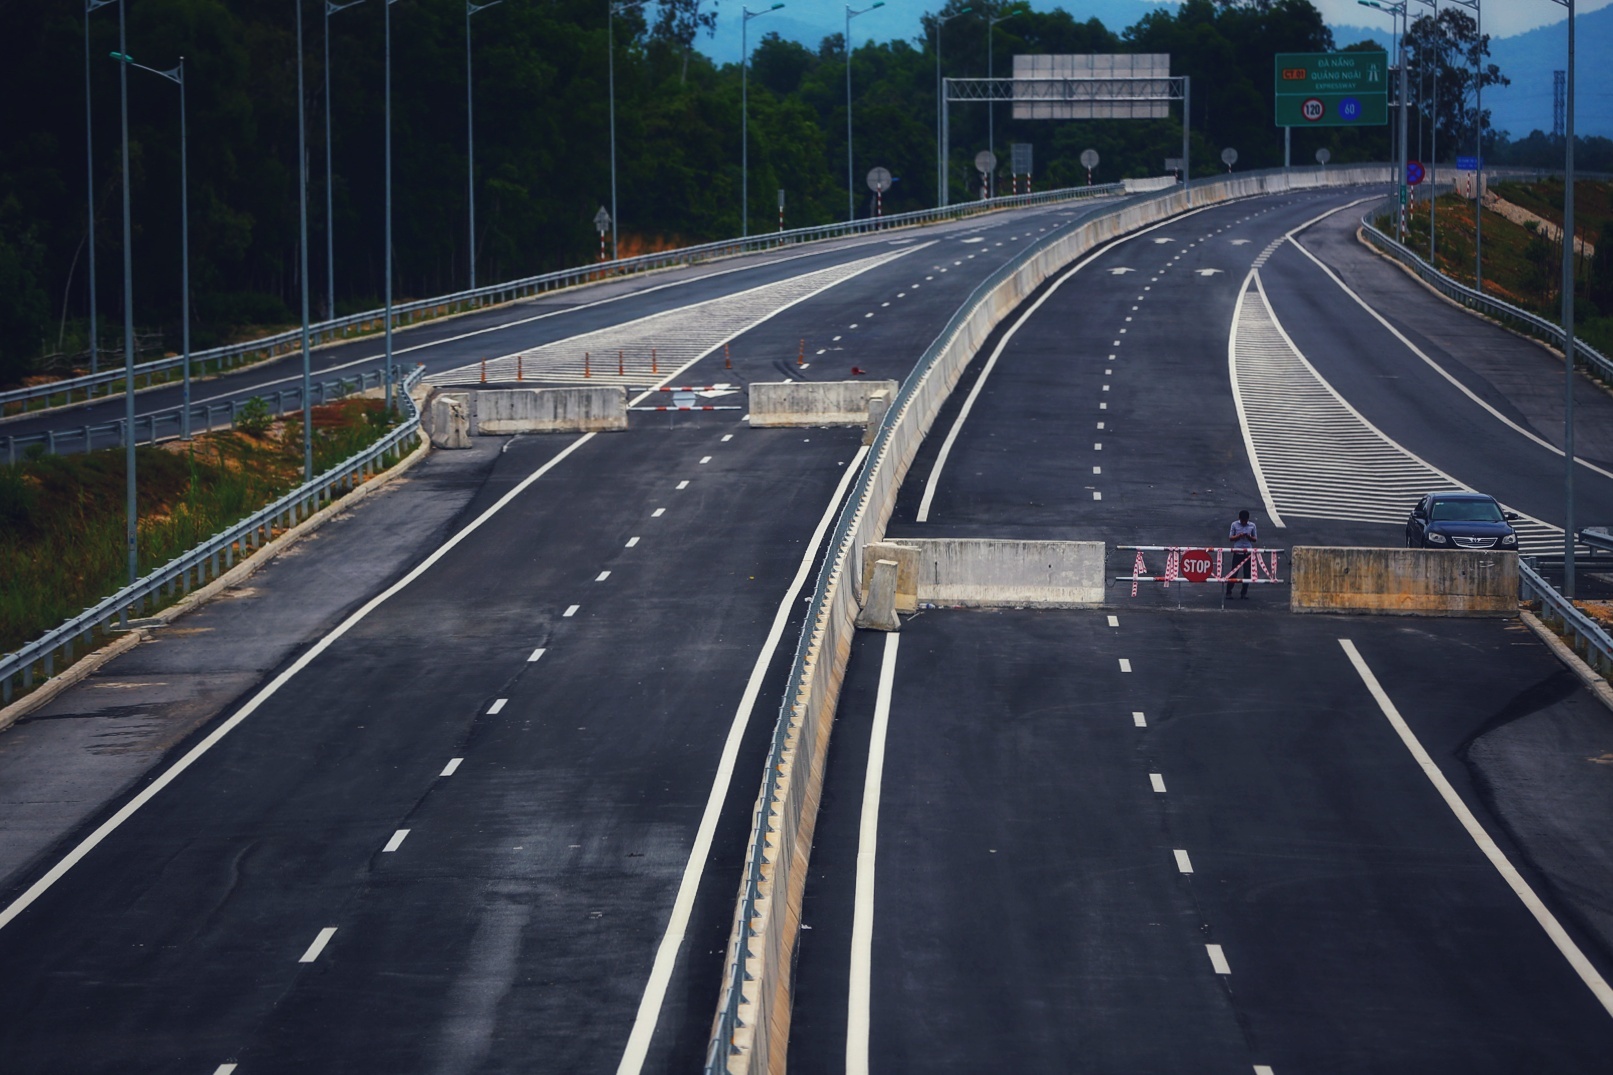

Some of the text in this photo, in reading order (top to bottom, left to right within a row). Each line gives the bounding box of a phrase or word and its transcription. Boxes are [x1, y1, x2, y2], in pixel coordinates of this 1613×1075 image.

[1306, 104, 1320, 115] 120
[1345, 104, 1355, 115] 60
[1184, 558, 1210, 574] STOP
